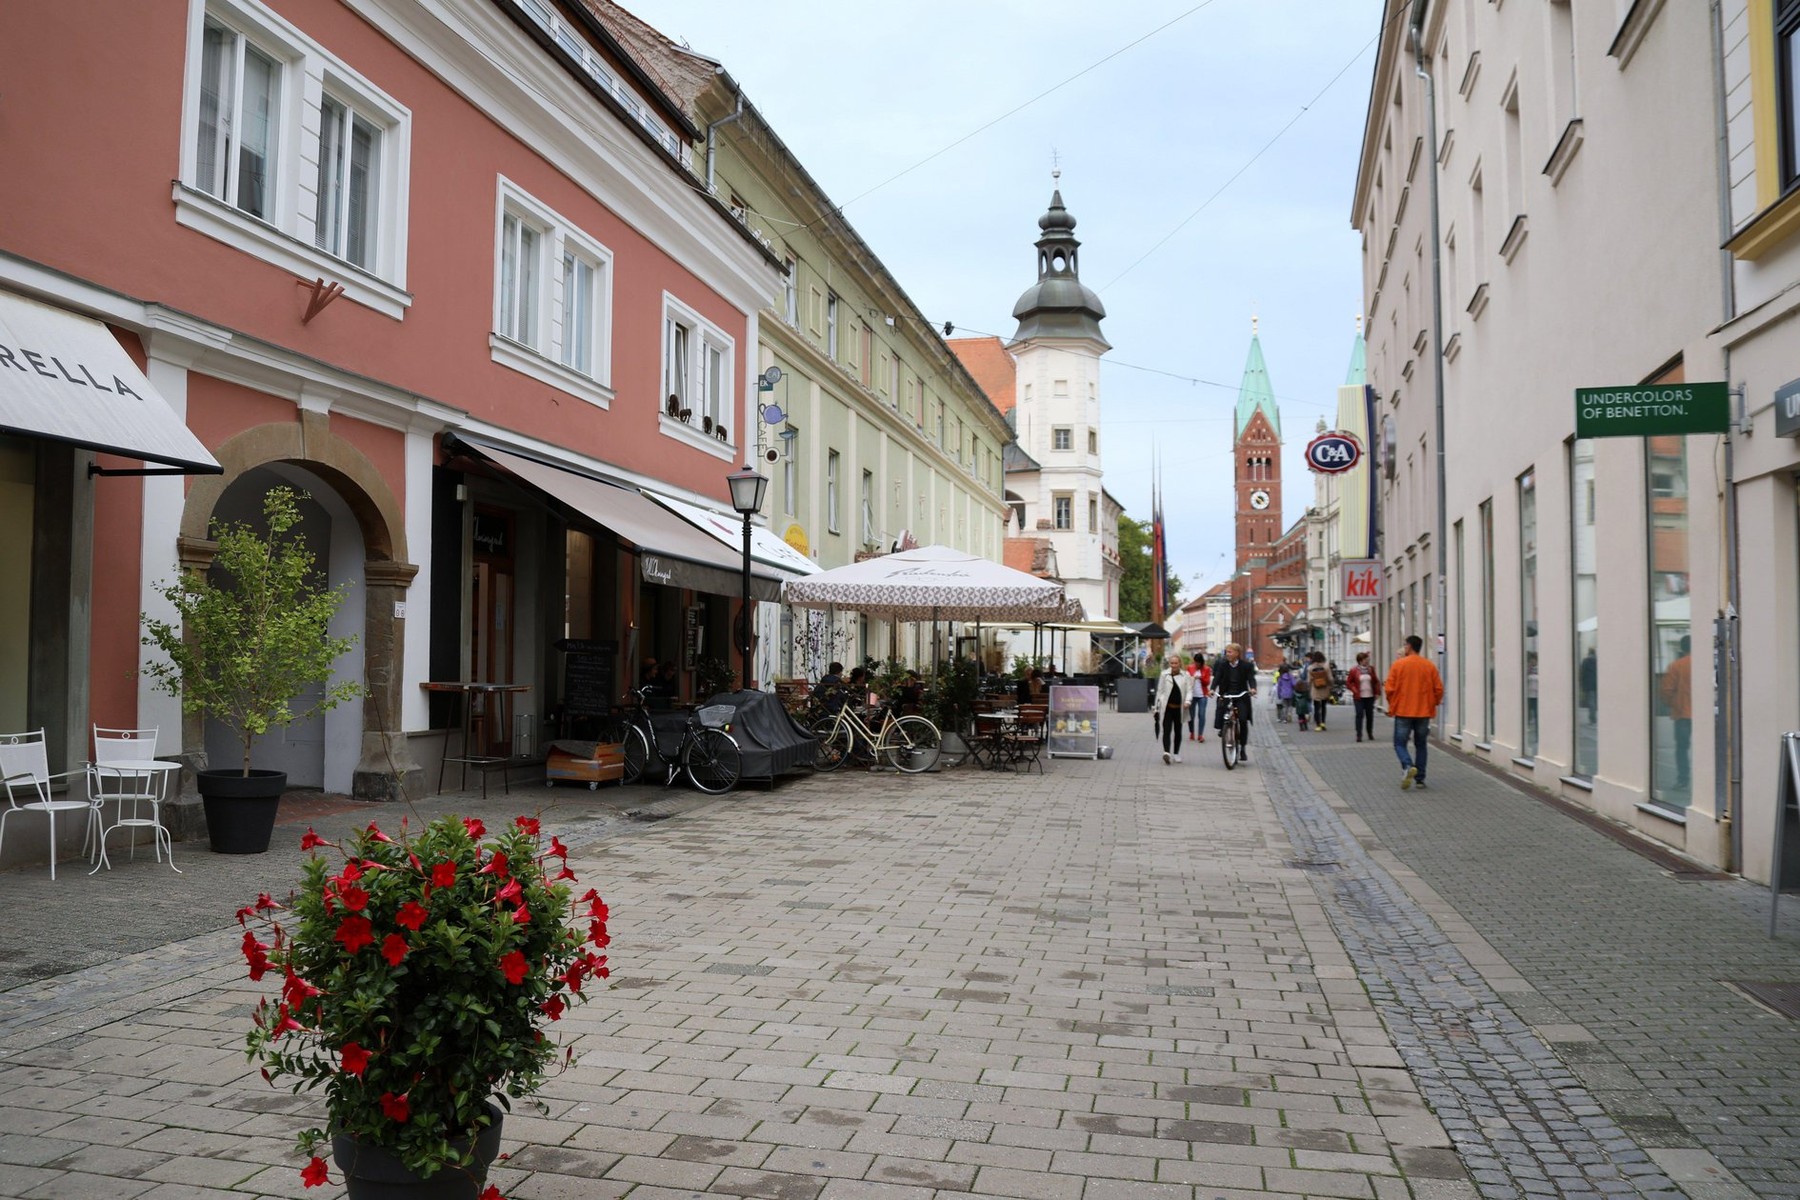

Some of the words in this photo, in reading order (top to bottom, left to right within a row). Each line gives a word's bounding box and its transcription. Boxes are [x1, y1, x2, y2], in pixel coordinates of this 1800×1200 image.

[1582, 389, 1693, 405] UNDERCOLORS
[1582, 407, 1602, 419] OF
[1315, 444, 1351, 462] C&A
